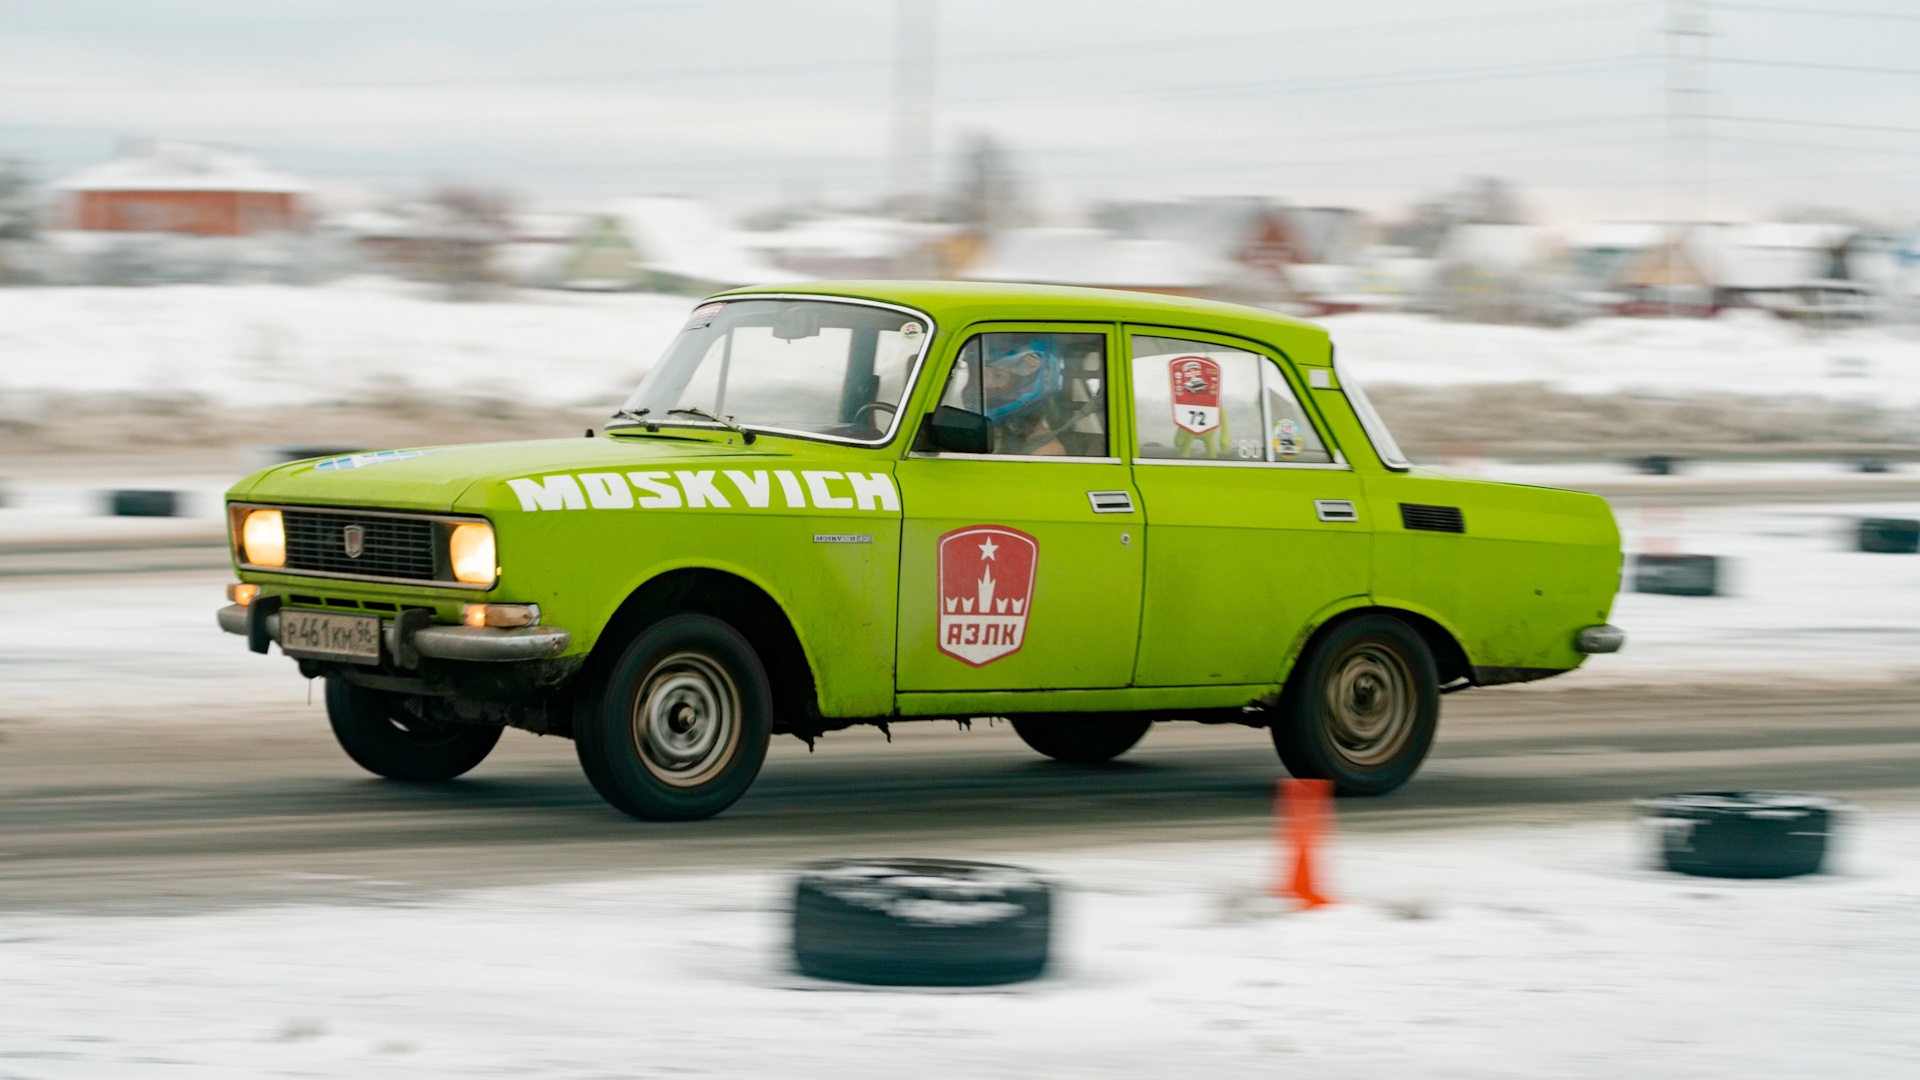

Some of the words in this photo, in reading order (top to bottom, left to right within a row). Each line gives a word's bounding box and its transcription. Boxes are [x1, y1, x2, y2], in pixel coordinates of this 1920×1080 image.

[1188, 410, 1206, 427] 72
[506, 469, 901, 512] MOSKVICH
[947, 623, 1017, 646] АЗЛК
